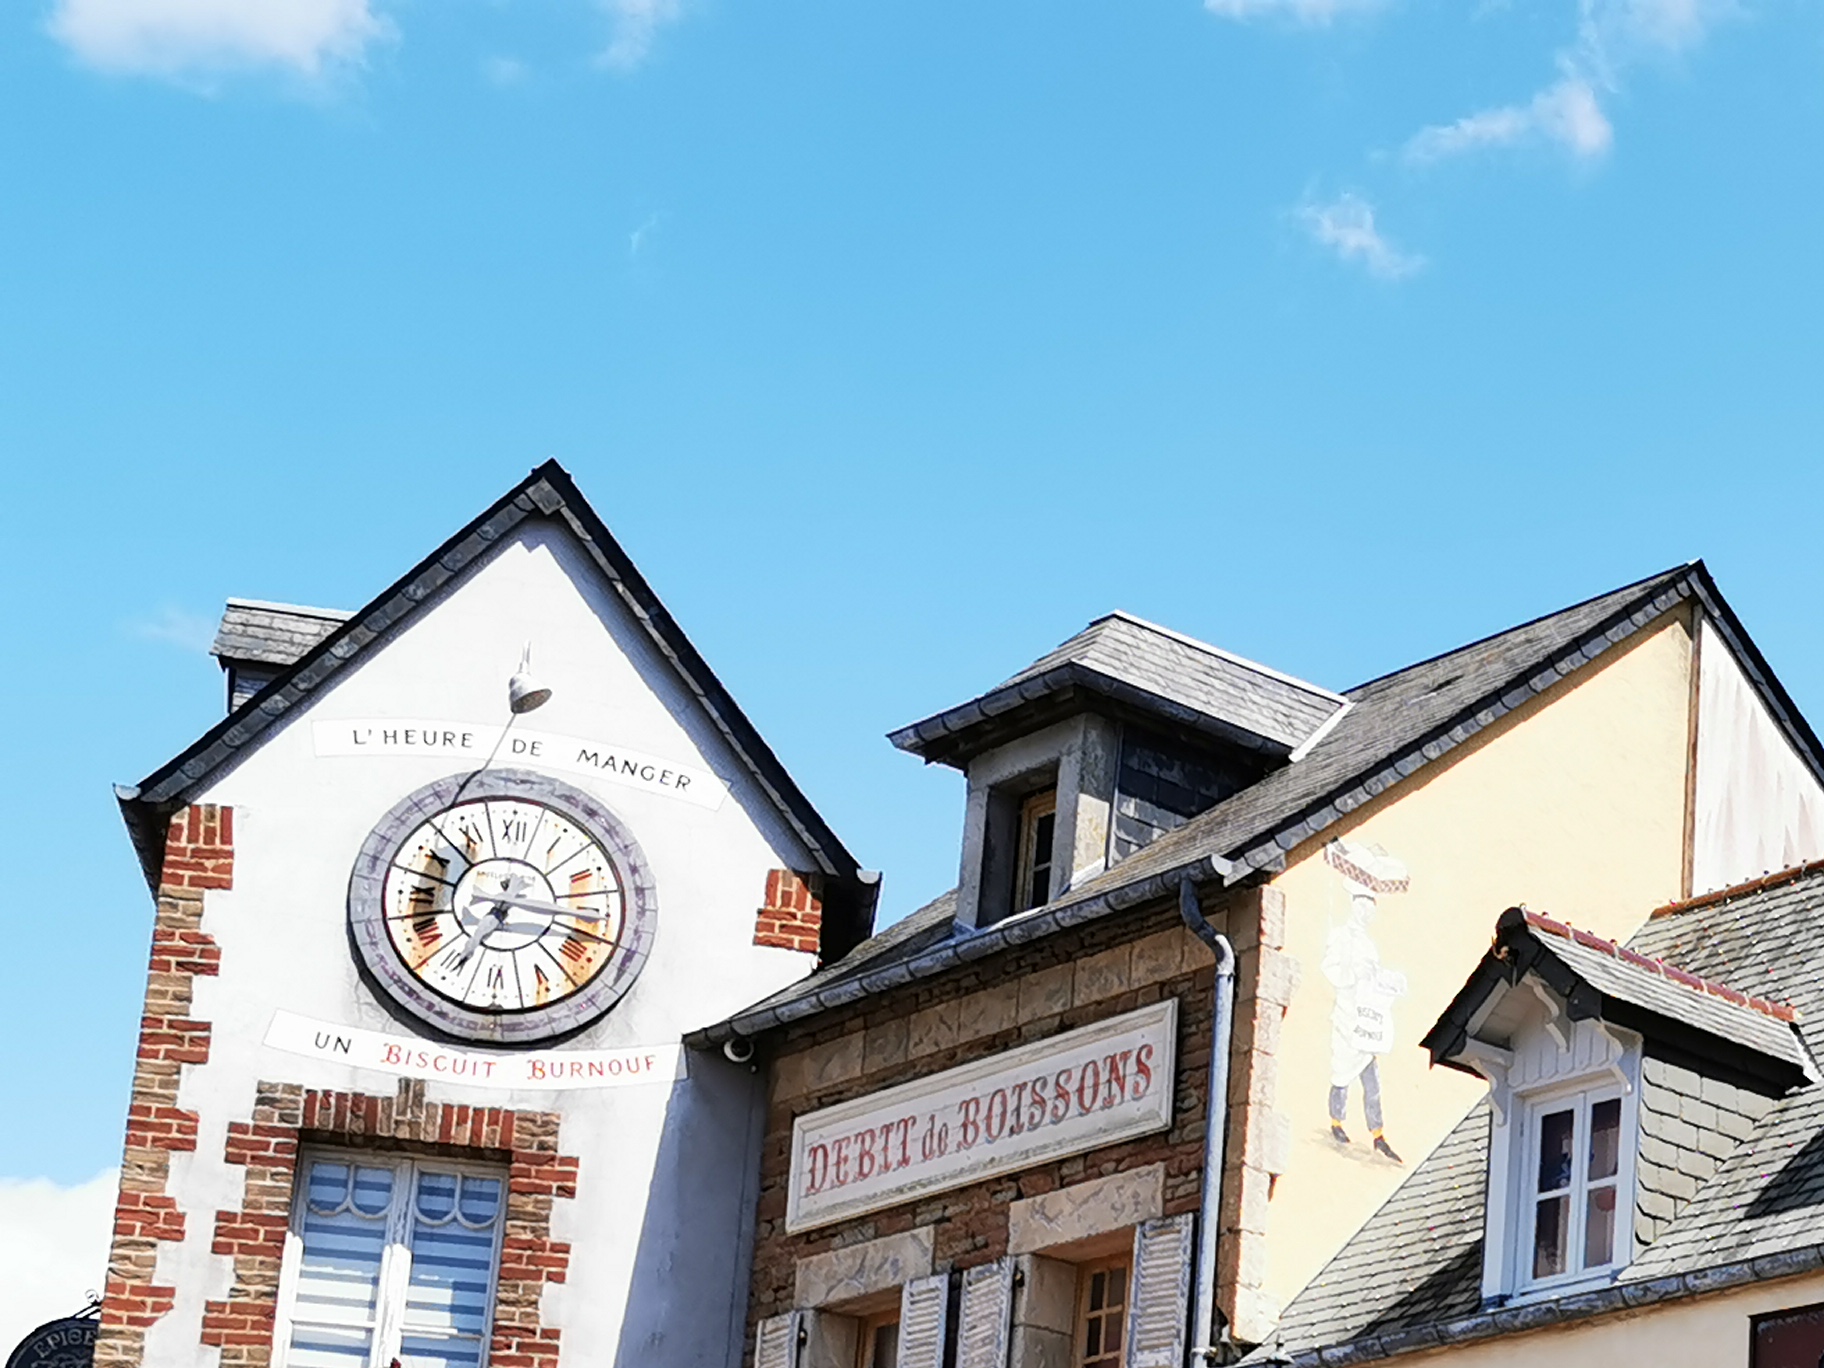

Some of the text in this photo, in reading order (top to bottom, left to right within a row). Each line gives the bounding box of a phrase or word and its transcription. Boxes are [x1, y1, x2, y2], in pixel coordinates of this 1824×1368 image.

[352, 729, 692, 793] L'HEURE DE MANGER
[502, 819, 527, 843] XII
[314, 1032, 657, 1080] UN BISCUIT BURNOUF
[805, 1043, 1156, 1194] DEBIT de BOISSONS
